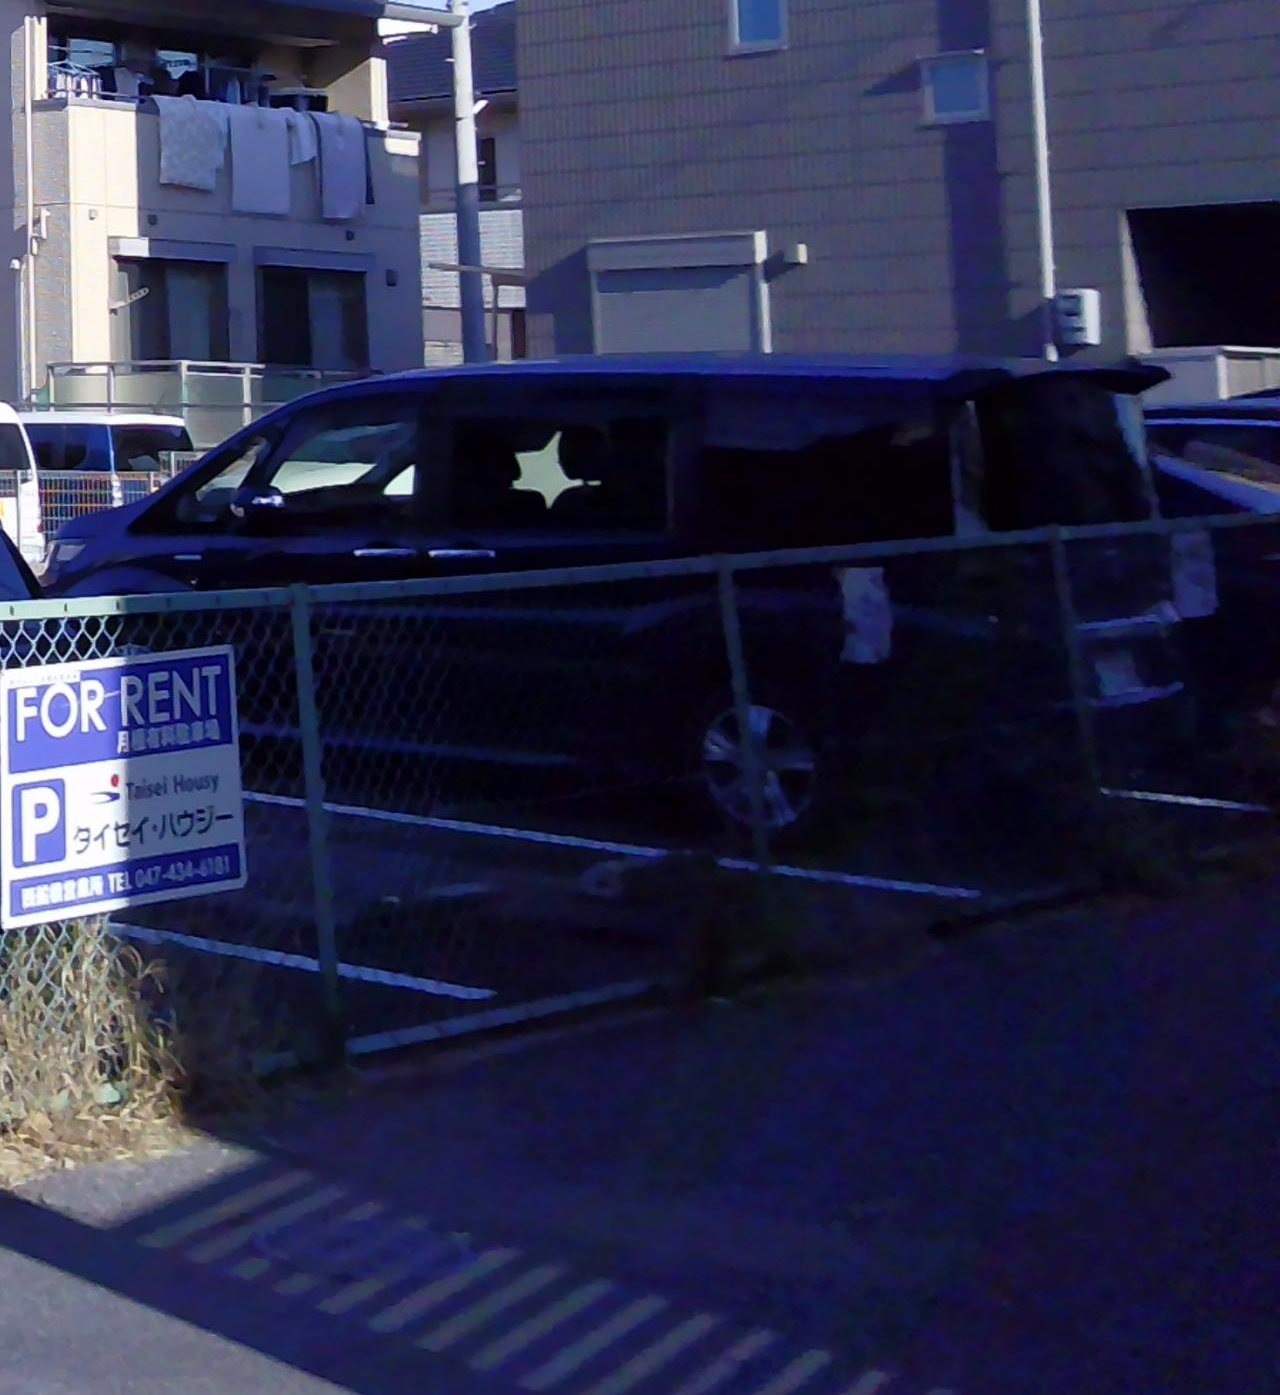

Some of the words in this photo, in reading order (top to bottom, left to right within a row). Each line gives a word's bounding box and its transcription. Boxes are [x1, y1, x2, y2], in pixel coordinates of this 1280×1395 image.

[15, 679, 107, 742] FOR
[119, 666, 222, 727] RENT
[125, 774, 167, 801] Taisei
[173, 773, 219, 794] Housy
[20, 787, 61, 863] P
[73, 806, 234, 855] タイセイ・ハウジー
[107, 871, 131, 894] TEL
